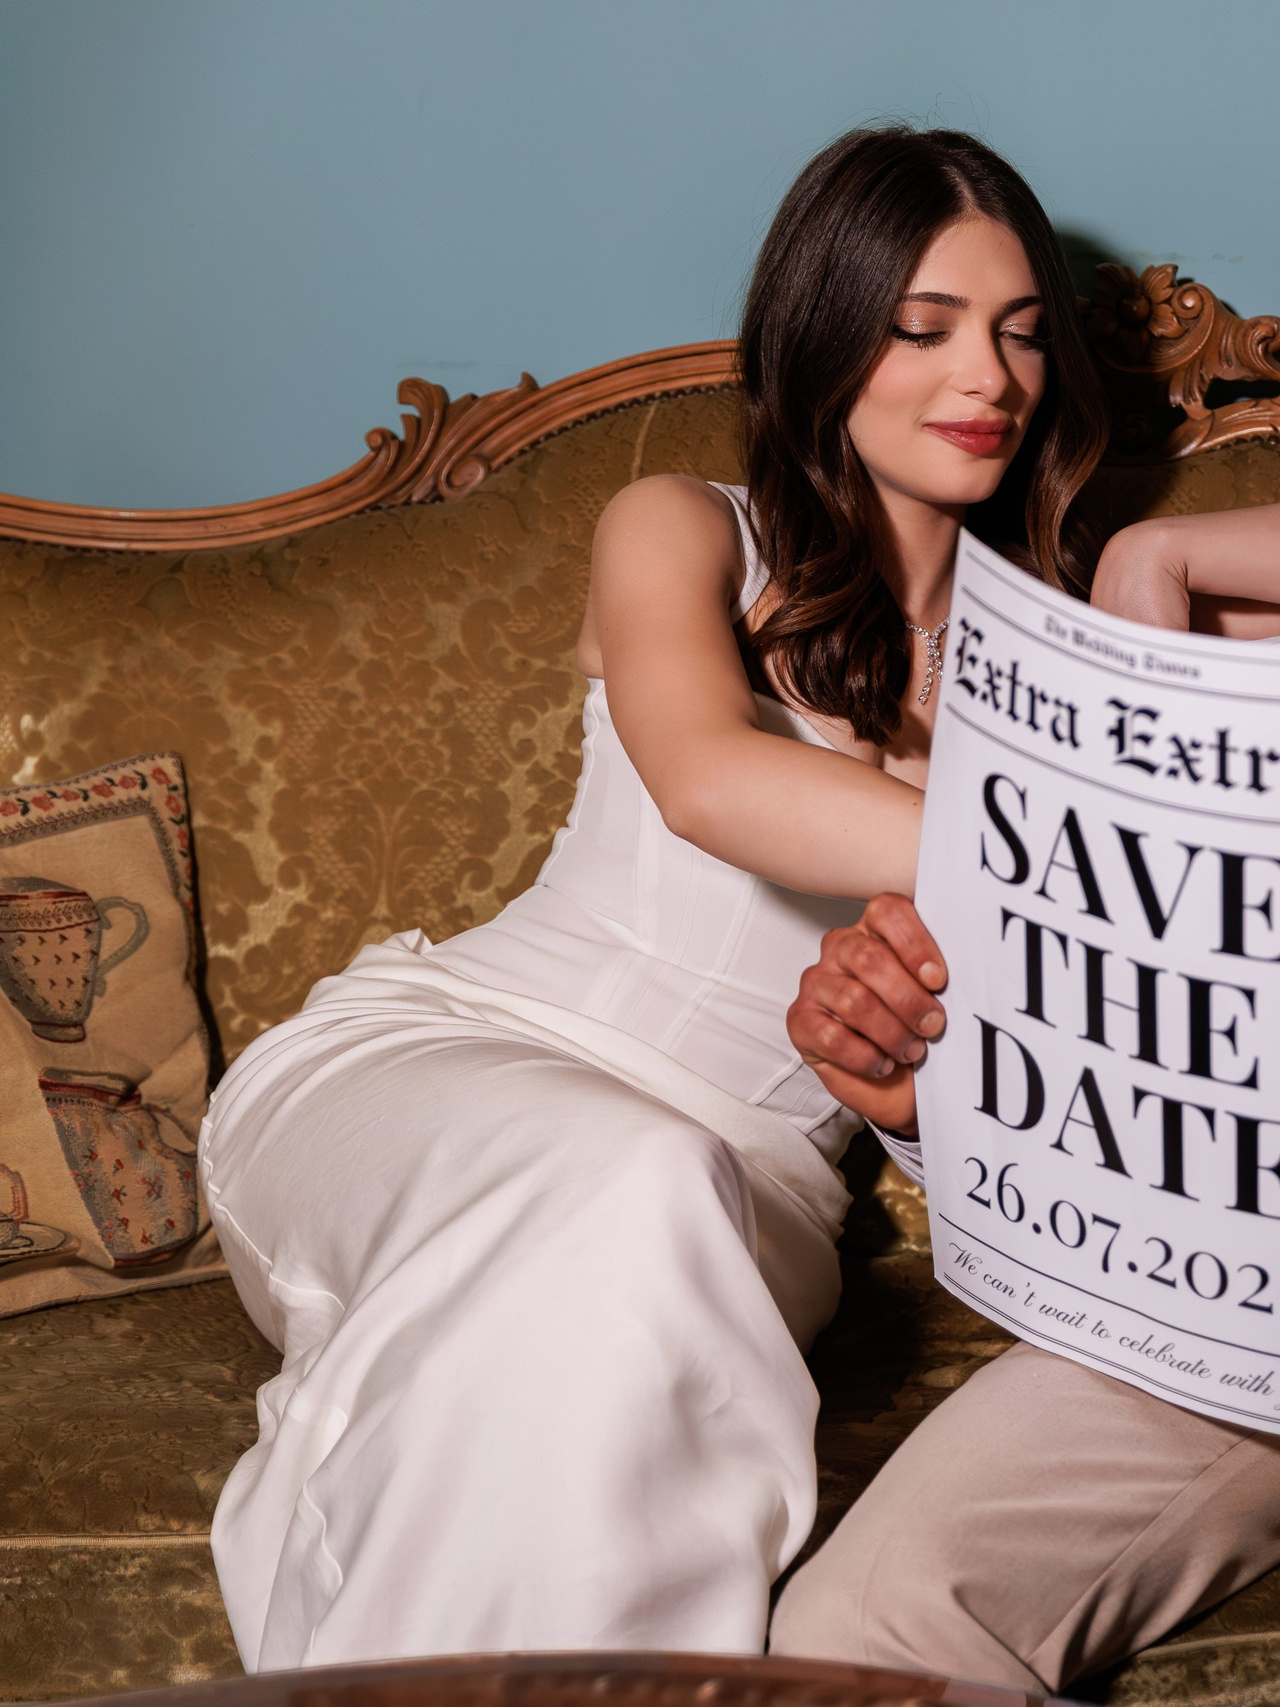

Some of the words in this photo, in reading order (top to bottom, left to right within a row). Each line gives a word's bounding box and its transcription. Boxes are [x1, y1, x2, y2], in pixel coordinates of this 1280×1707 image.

[953, 617, 1081, 750] Extra
[1044, 614, 1067, 642] The
[1070, 623, 1136, 668] Wedding
[1143, 654, 1201, 680] Times
[1000, 905, 1259, 1091] THE
[948, 1241, 983, 1277] We
[1039, 1294, 1088, 1332] wait
[1089, 1316, 1112, 1339] to
[1118, 1332, 1212, 1380] celebrate
[1219, 1367, 1274, 1398] with
